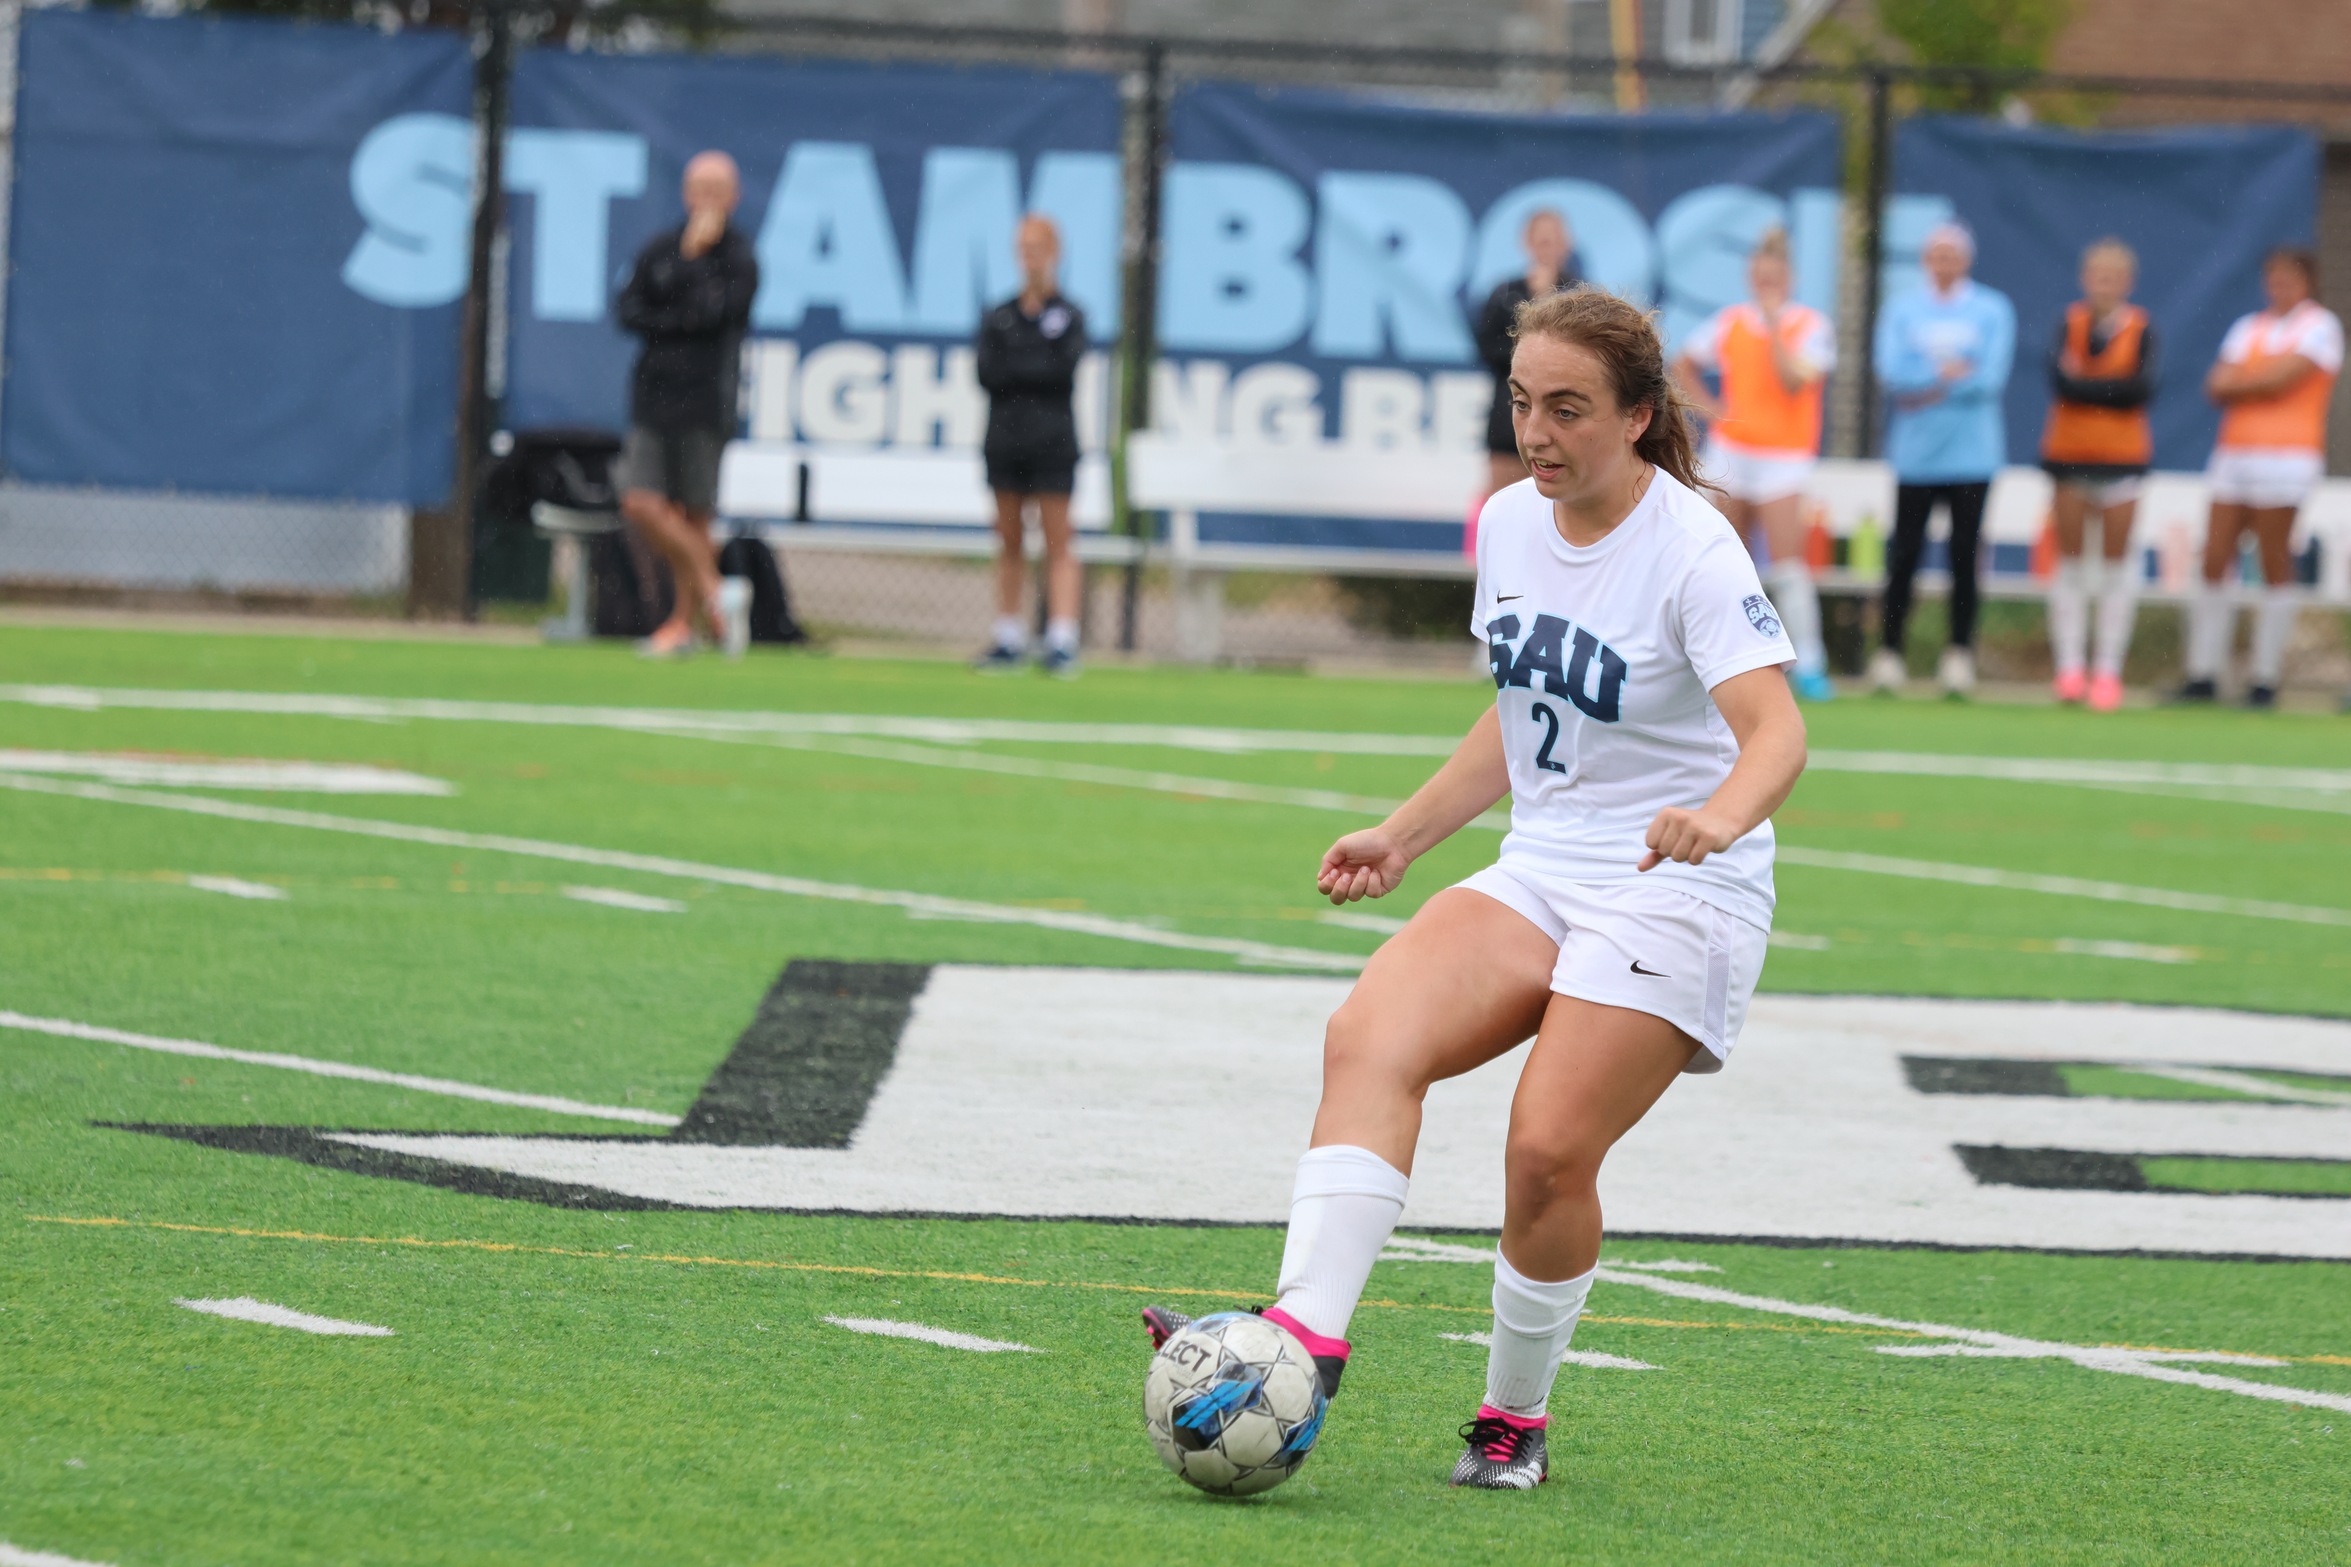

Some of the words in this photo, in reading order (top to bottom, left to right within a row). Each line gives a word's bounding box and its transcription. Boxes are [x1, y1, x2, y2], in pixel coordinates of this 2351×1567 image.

[342, 112, 650, 321] ST
[738, 336, 1318, 448] IGHING
[1340, 365, 1492, 452] BE
[1748, 603, 1779, 624] SAU
[1486, 611, 1629, 723] SAU
[1531, 702, 1568, 775] 2
[1159, 1340, 1212, 1373] LECT
